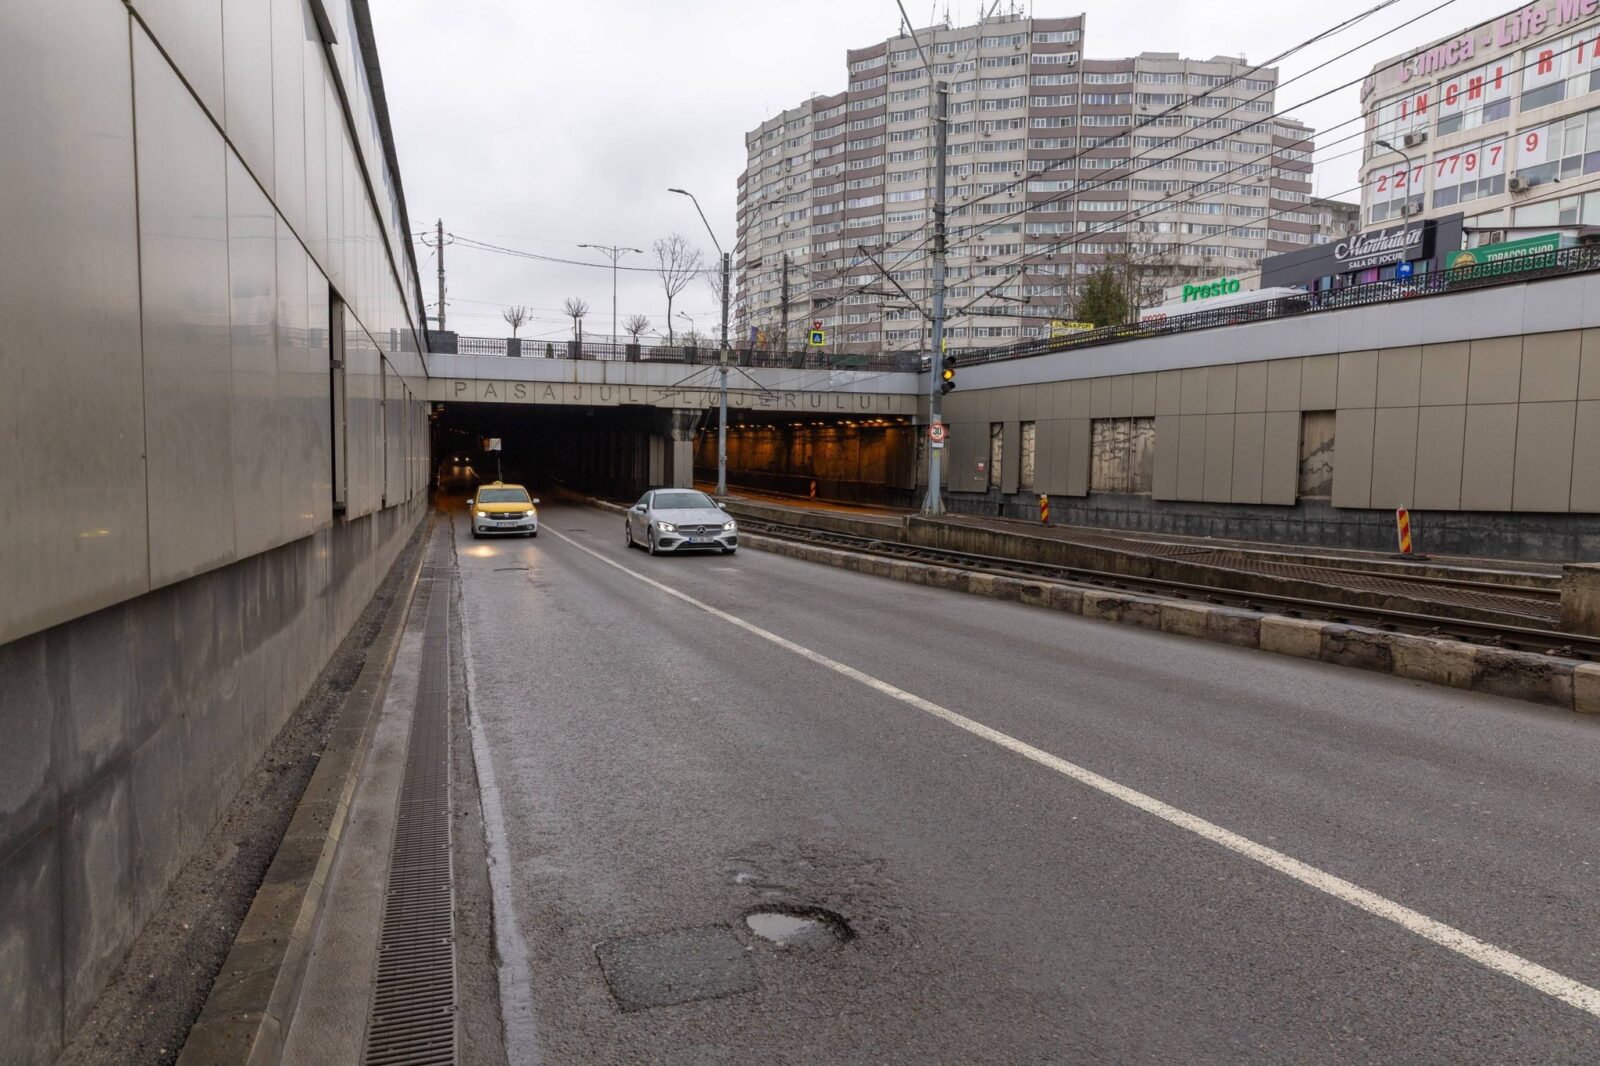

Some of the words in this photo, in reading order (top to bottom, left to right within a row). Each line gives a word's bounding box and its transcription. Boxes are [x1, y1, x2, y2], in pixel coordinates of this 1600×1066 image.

[1497, 6, 1547, 48] Life
[1348, 260, 1366, 270] SALA
[1367, 257, 1378, 266] DE
[1182, 277, 1240, 303] Presto
[454, 381, 638, 402] PASAJUL
[932, 426, 942, 435] 30
